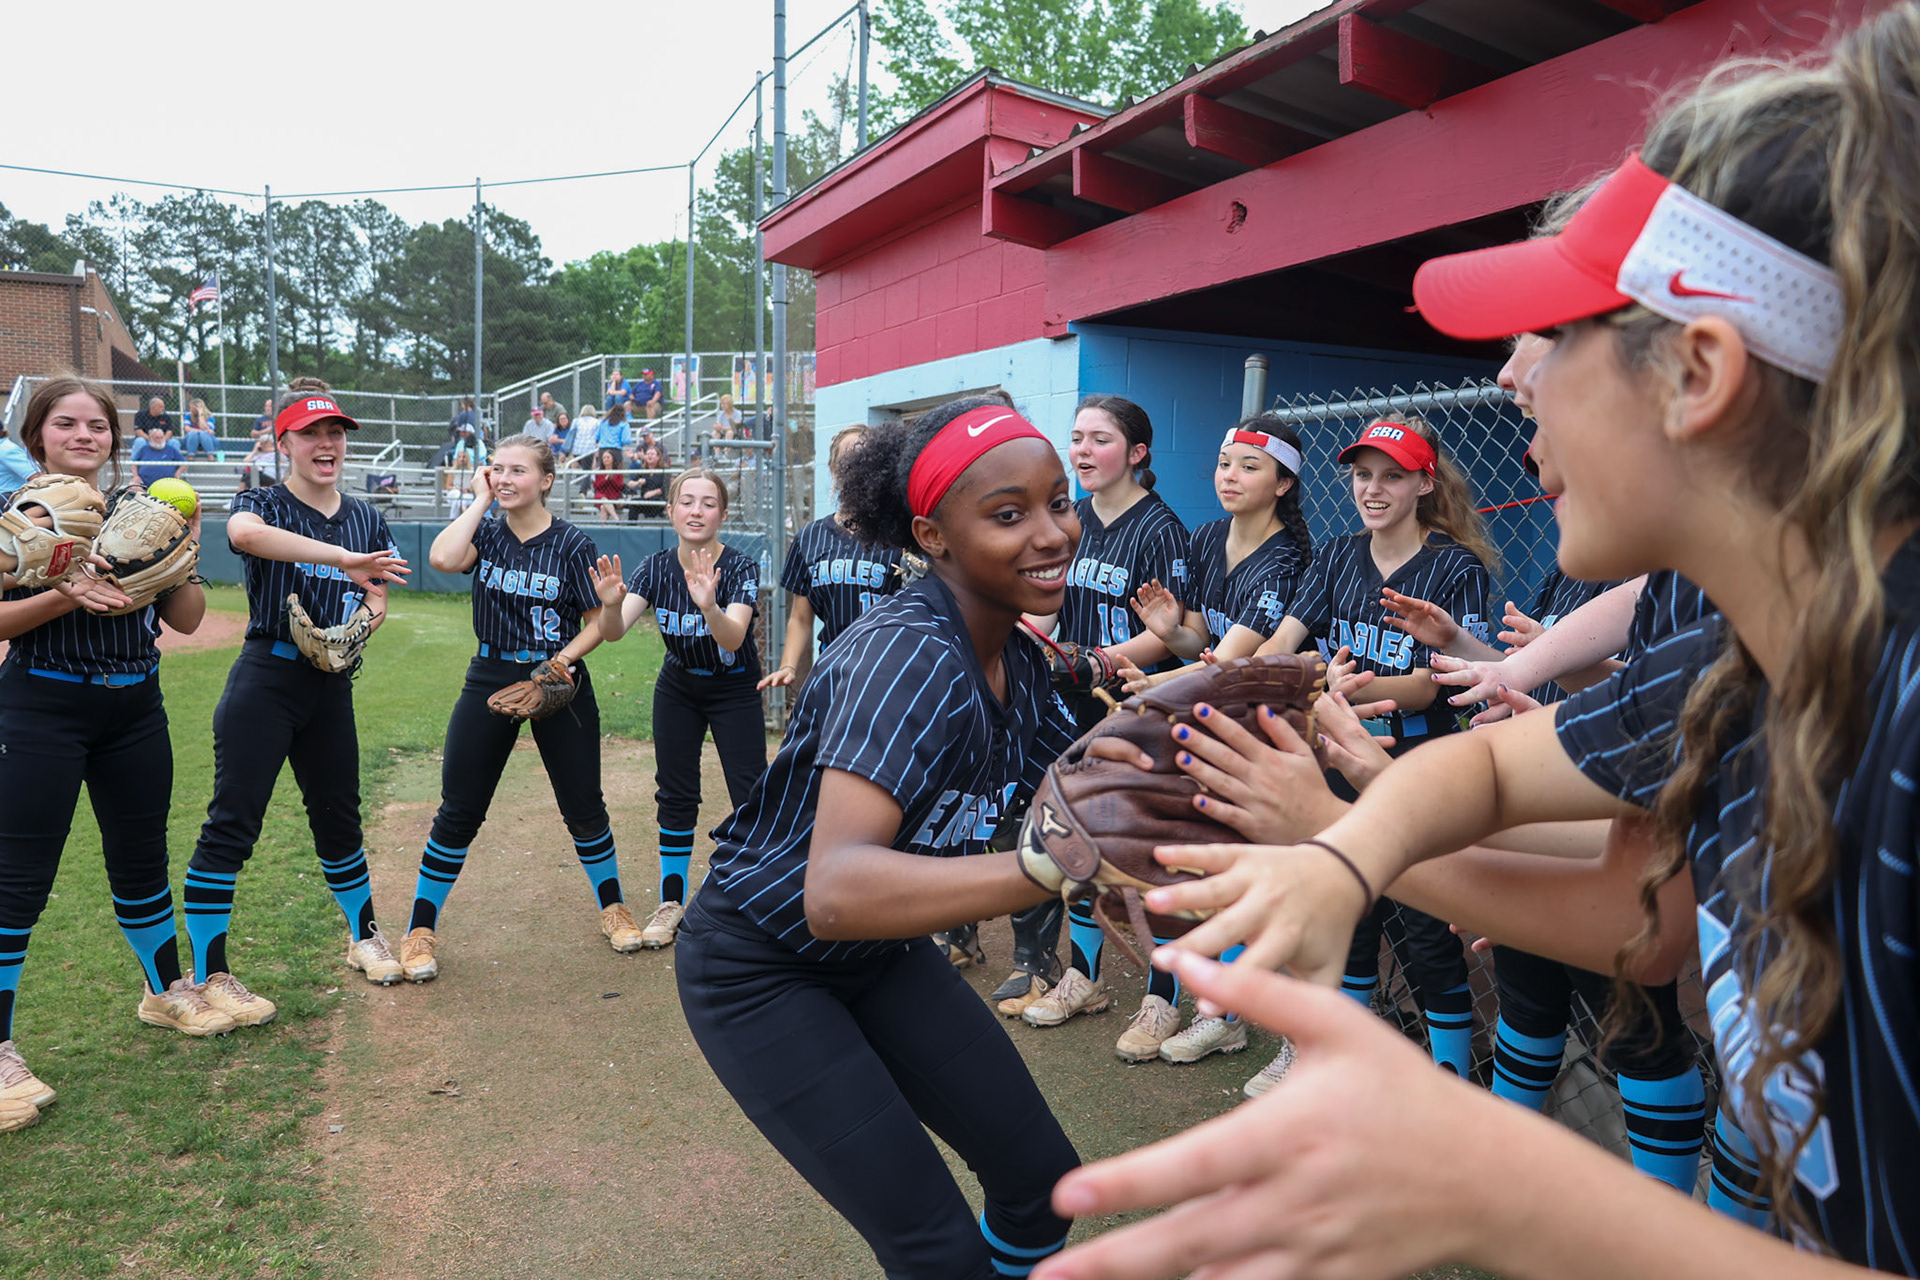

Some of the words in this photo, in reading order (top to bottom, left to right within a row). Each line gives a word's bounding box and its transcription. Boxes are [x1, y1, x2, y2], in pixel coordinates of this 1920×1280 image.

[306, 399, 334, 411] SBA
[1368, 426, 1405, 441] SBA
[480, 559, 561, 602] EAGLES
[809, 558, 887, 589] EAGLES
[530, 606, 561, 641] 12
[1097, 603, 1131, 646] 18
